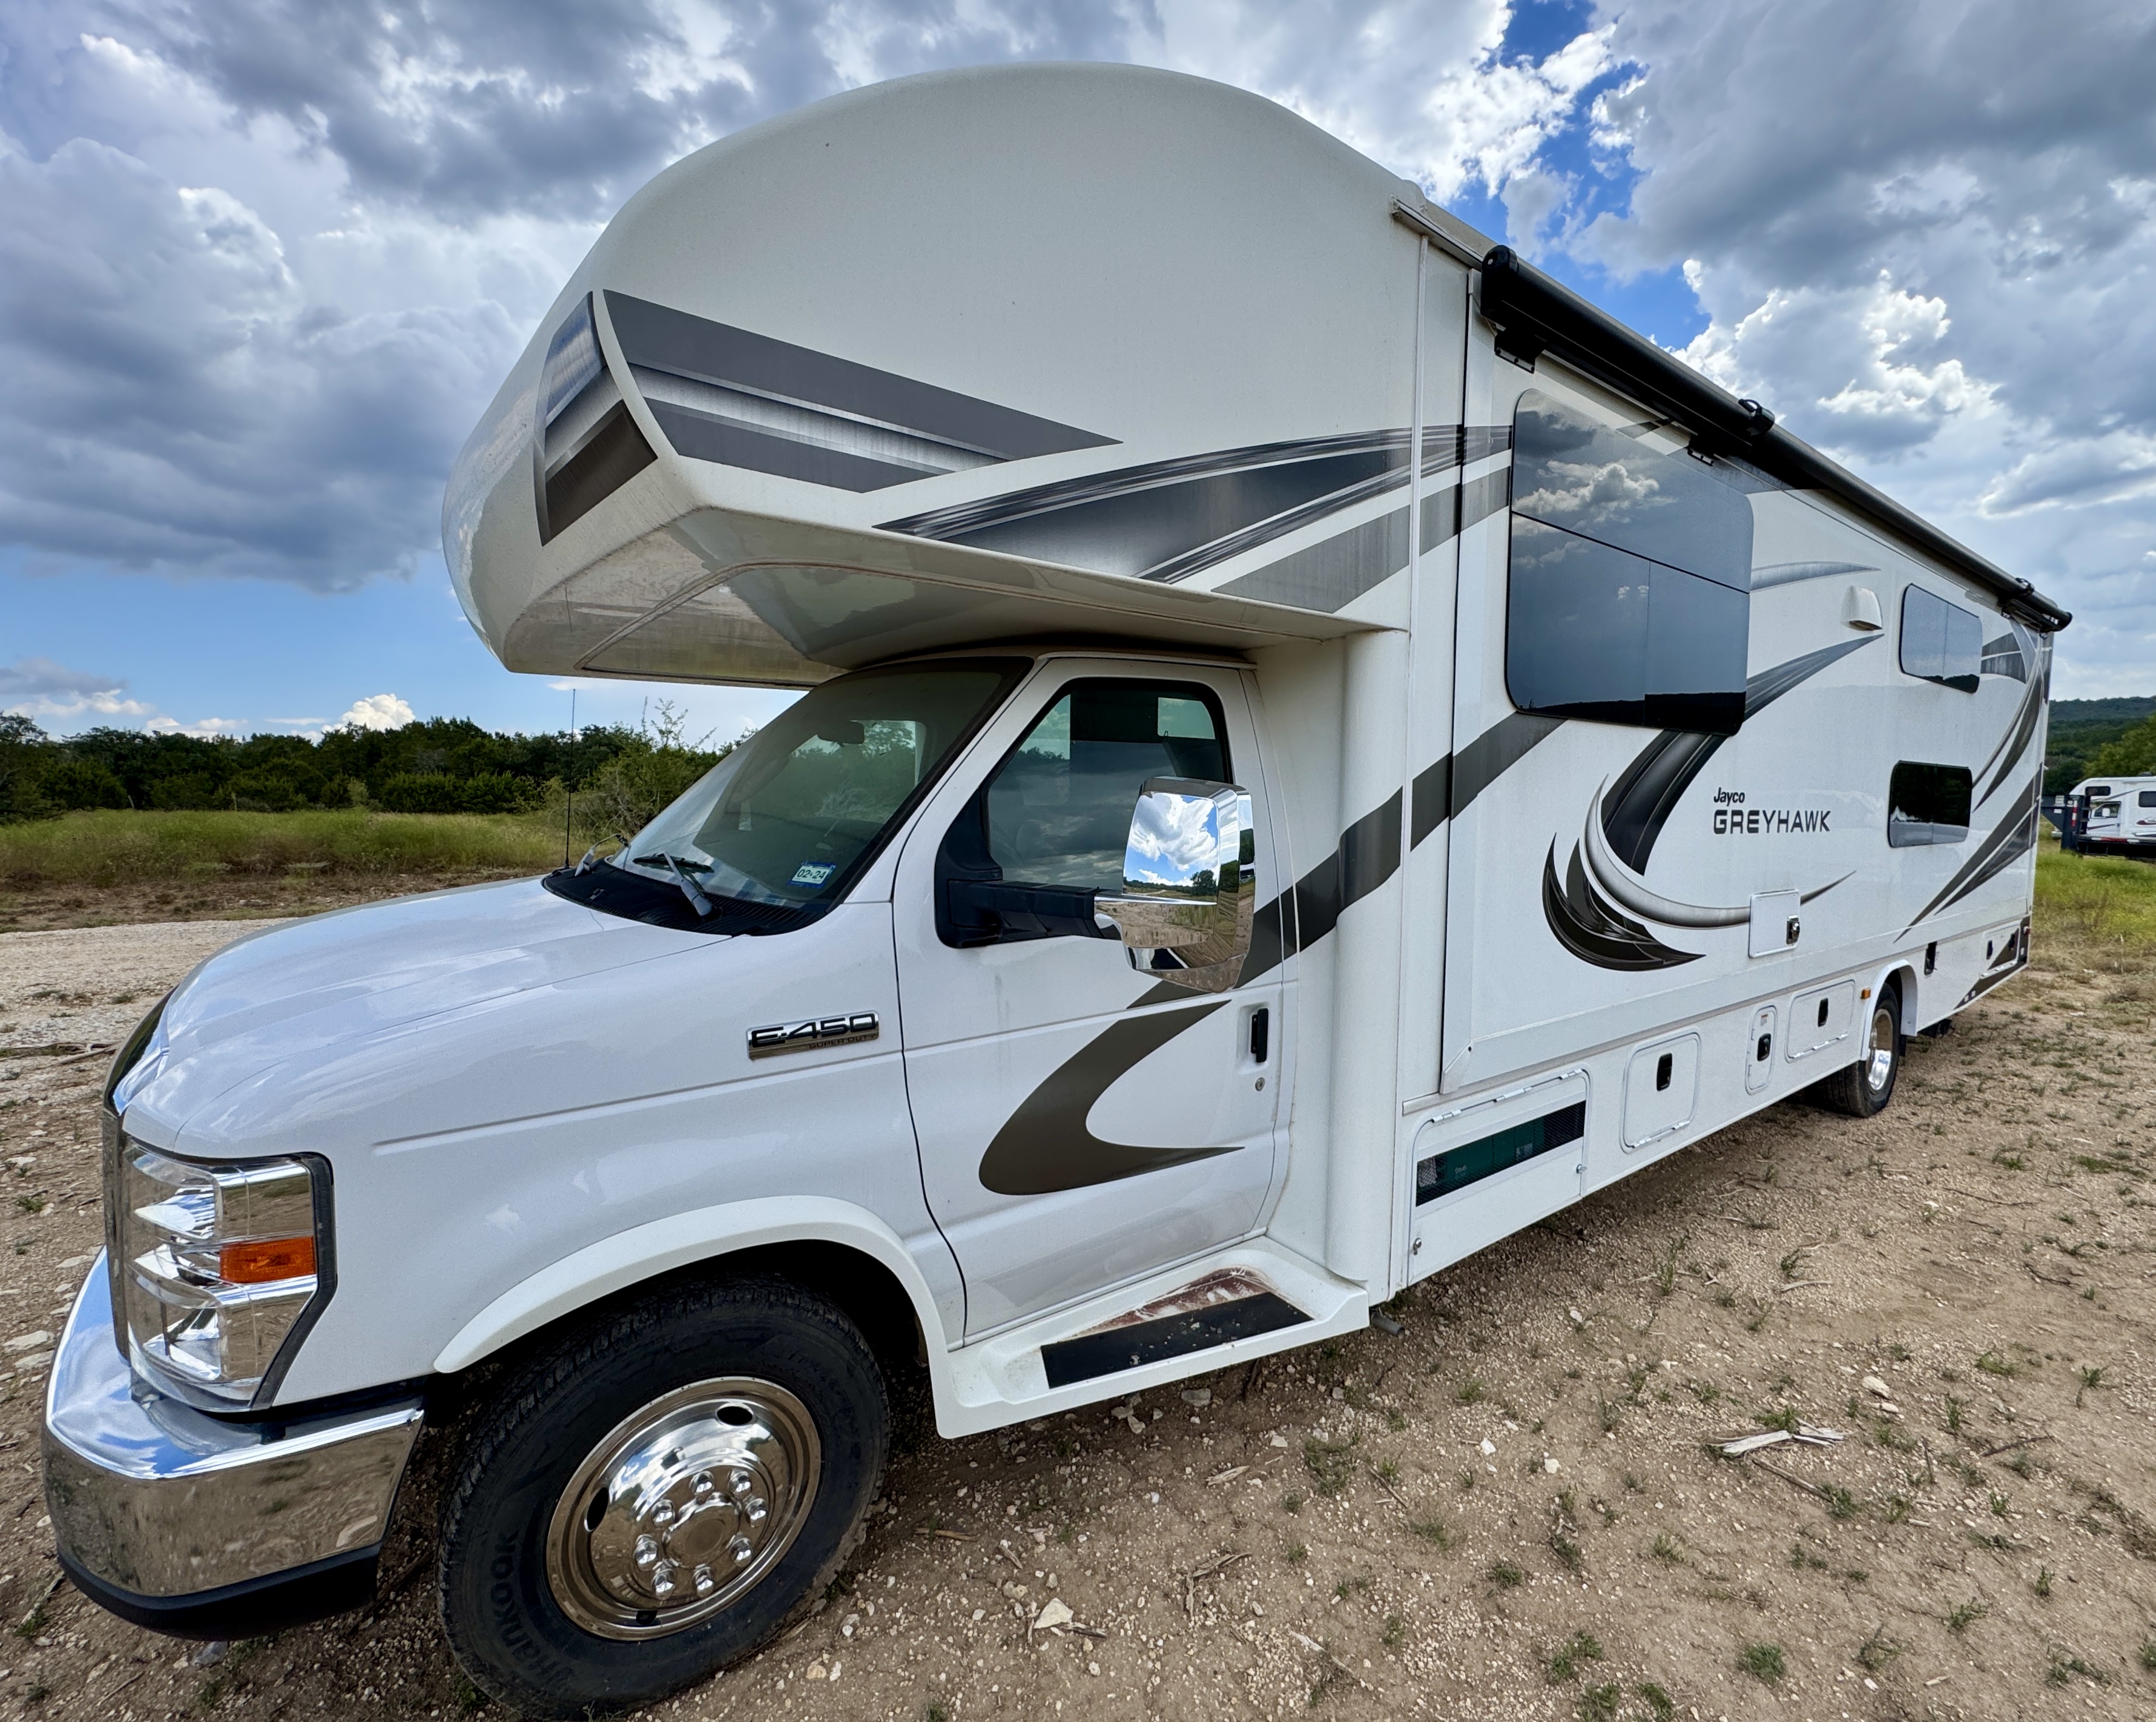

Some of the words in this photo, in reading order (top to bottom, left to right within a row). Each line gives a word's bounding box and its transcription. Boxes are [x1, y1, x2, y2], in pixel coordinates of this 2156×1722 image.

[1713, 787, 1745, 807] Jayco
[1713, 810, 1831, 835] GREYHAWK
[751, 1013, 877, 1048] E-450
[809, 1038, 845, 1049] SUPER
[847, 1033, 875, 1043] DUTY
